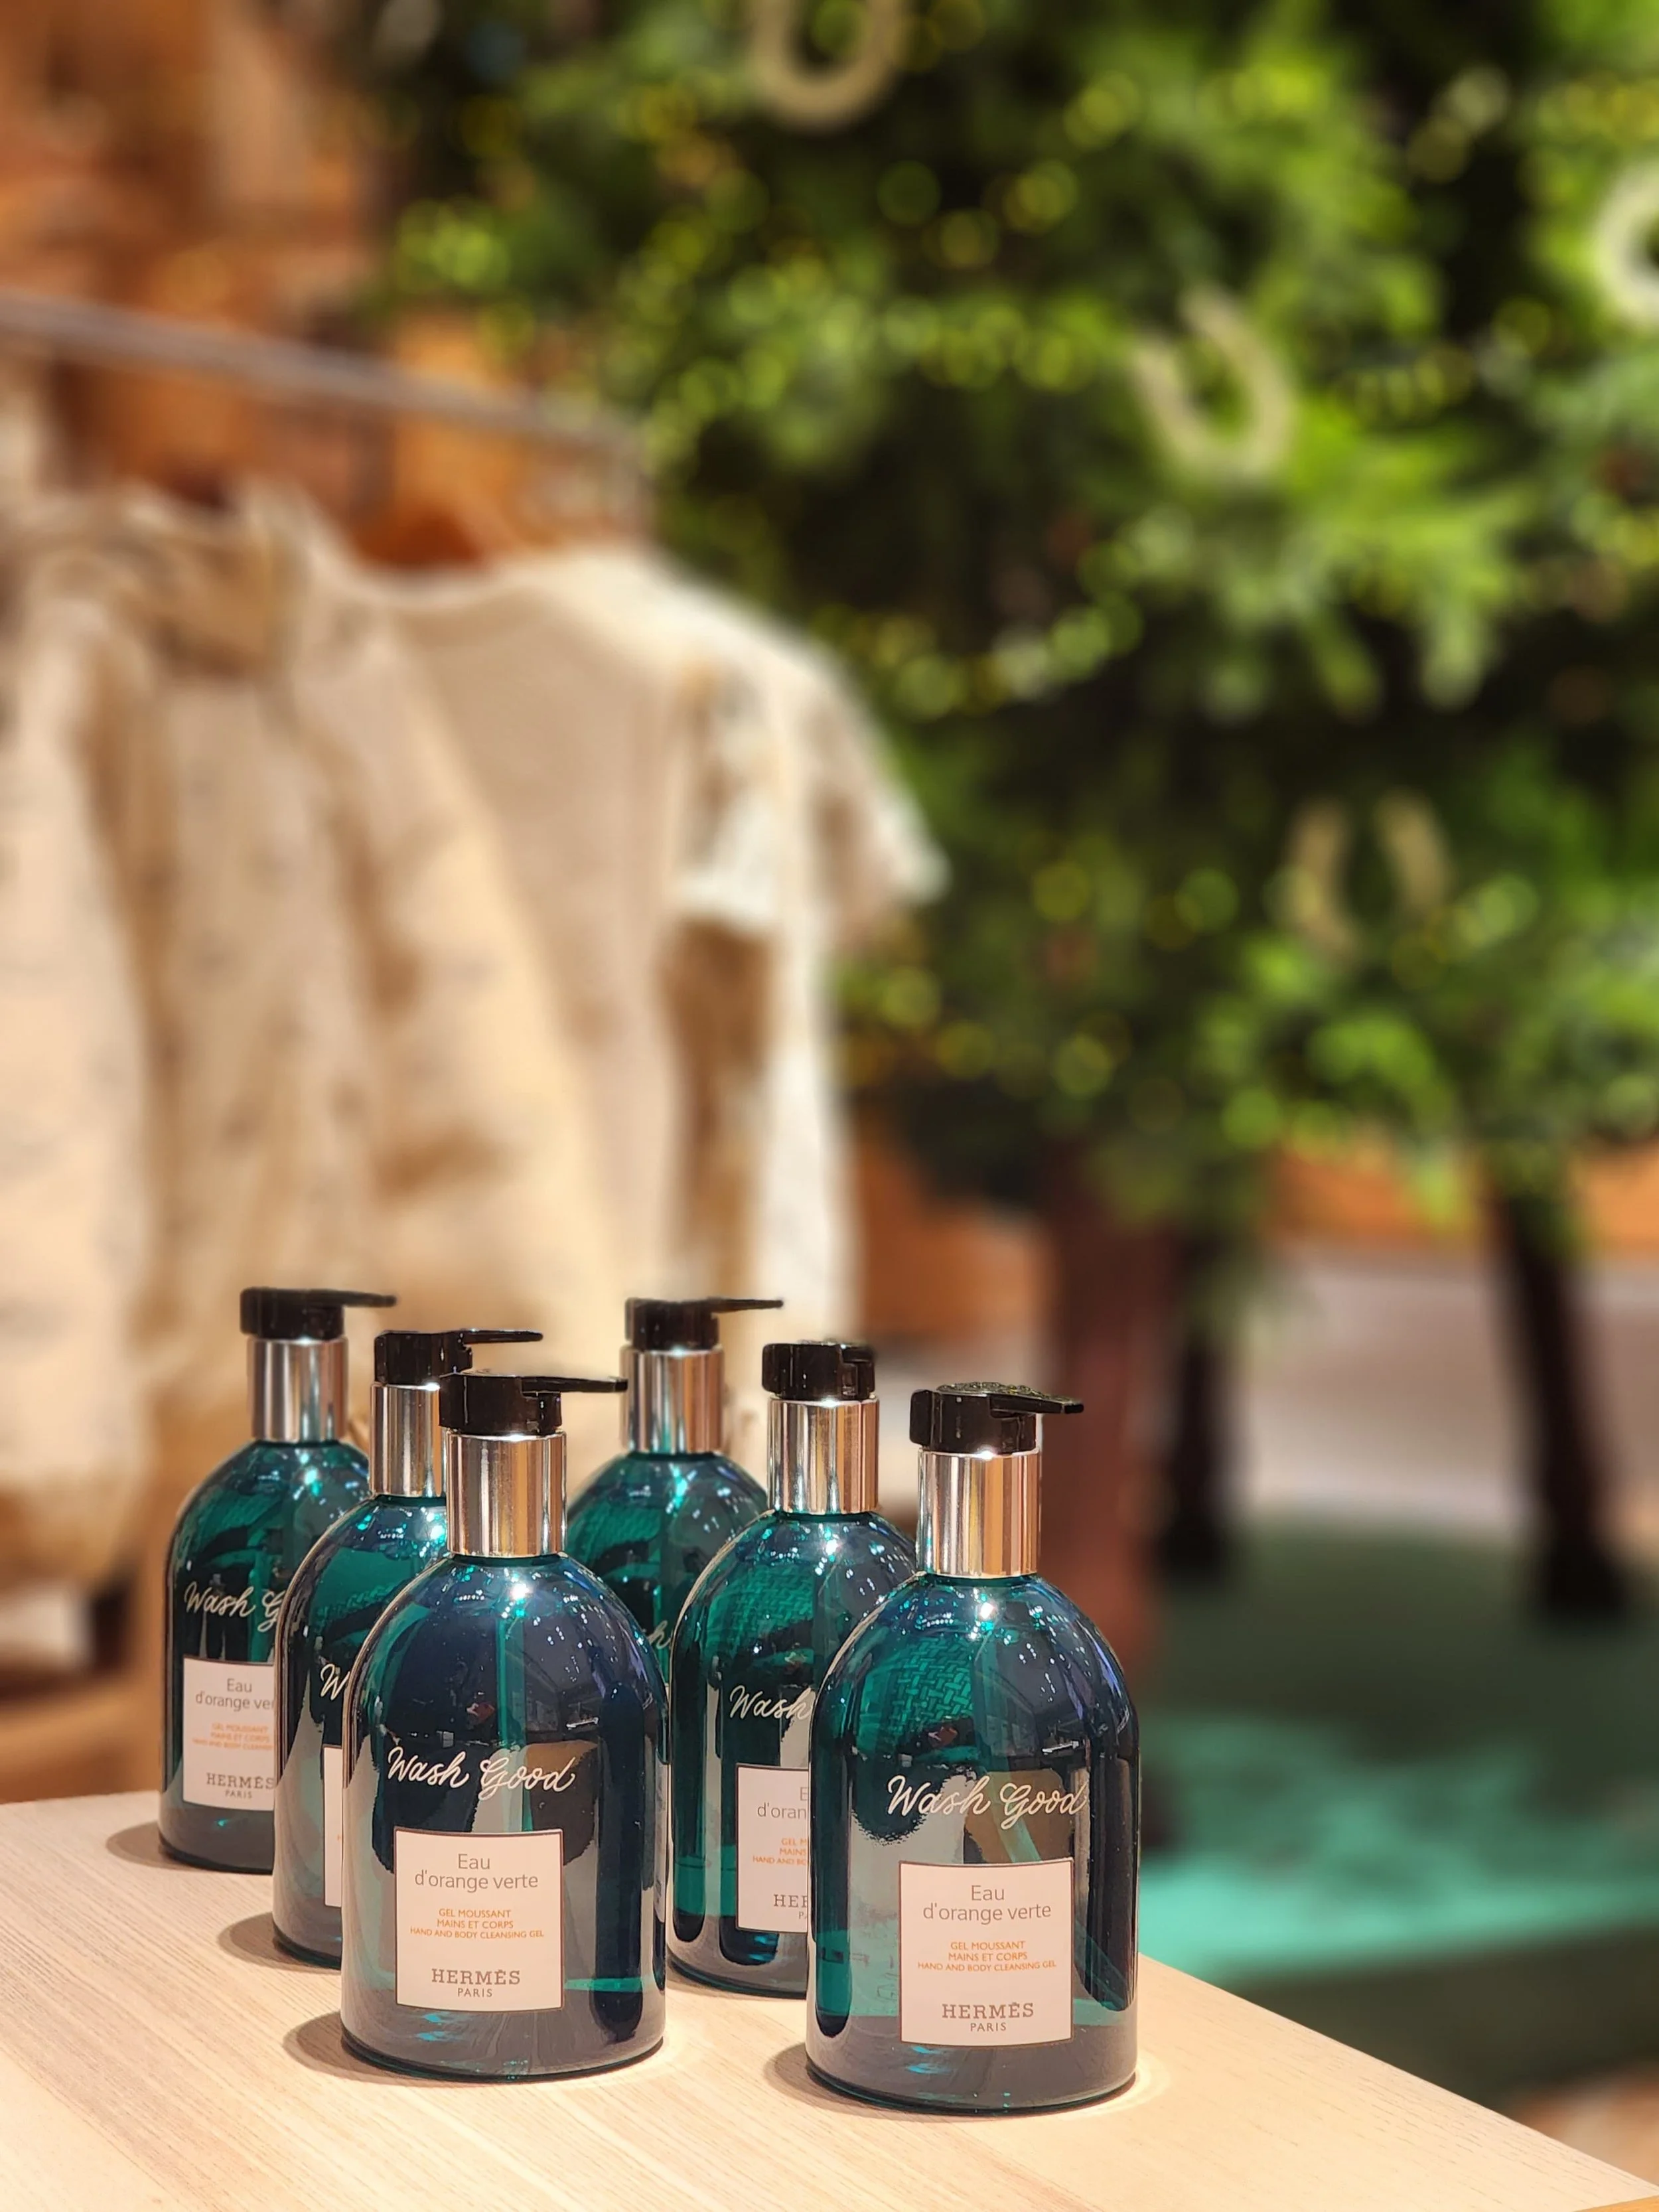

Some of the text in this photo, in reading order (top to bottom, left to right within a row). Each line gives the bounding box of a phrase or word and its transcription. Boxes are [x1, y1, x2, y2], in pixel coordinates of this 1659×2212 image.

[184, 1581, 256, 1617] Wash
[227, 1678, 252, 1692] Eau
[195, 1690, 251, 1712] d'orange
[730, 1685, 813, 1720] Wash
[388, 1746, 575, 1801] Wash Good
[225, 1789, 252, 1799] PARIS
[888, 1775, 1089, 1830] Wash Good
[757, 1802, 807, 1819] d'oran
[458, 1854, 490, 1870] Eau
[753, 1856, 775, 1865] HAND
[414, 1869, 538, 1893] d'orange verte
[971, 1885, 1005, 1901] Eau
[439, 1908, 512, 1918] GEL MOUSSANT
[923, 1903, 1051, 1925] d'orange verte
[437, 1919, 514, 1929] MAINS ET CORPS
[410, 1926, 432, 1936] HAND
[434, 1929, 453, 1938] AND
[480, 1930, 527, 1939] CLEANSING
[950, 1941, 1026, 1951] GEL MOUSSANT
[948, 1951, 1028, 1962] MAINS ET CORPS
[918, 1962, 943, 1970] HAND
[993, 1961, 1041, 1972] CLEANSING
[457, 1988, 493, 1998] PARIS
[970, 2022, 1007, 2031] PARIS
